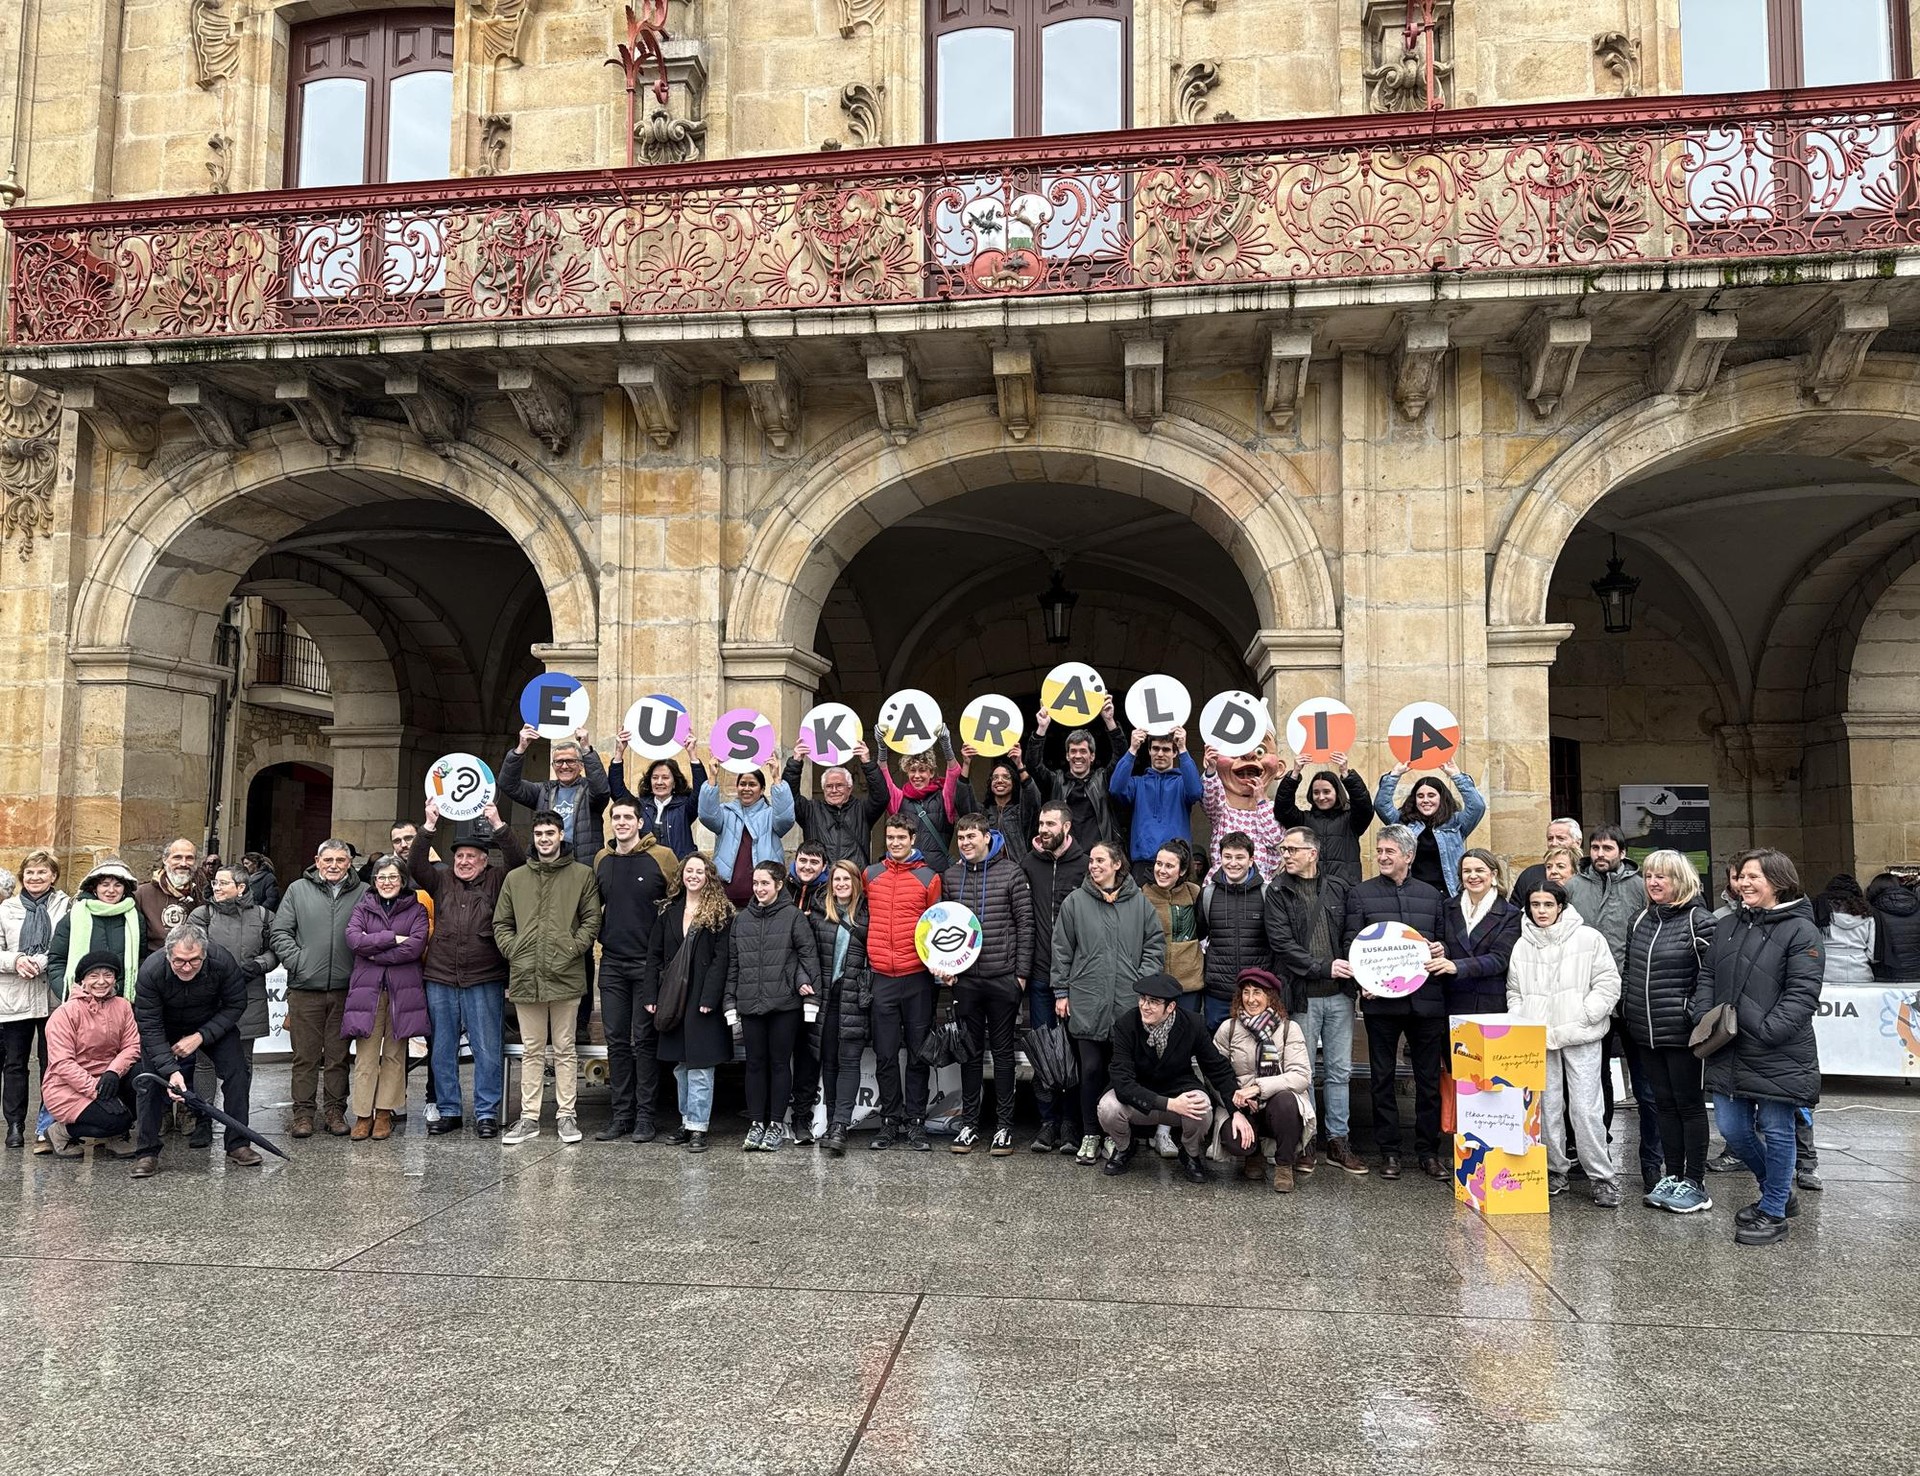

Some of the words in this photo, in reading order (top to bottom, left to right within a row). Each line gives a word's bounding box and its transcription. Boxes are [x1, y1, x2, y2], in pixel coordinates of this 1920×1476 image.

[538, 685, 572, 726] E
[1050, 675, 1091, 715] A
[1143, 688, 1175, 724] L
[637, 706, 679, 747] U
[726, 720, 761, 760] S
[813, 714, 852, 755] K
[891, 703, 932, 742] A
[973, 705, 1011, 747] R
[1210, 700, 1257, 745] D
[1314, 711, 1329, 750] I
[1409, 715, 1454, 762] A
[938, 951, 971, 968] AHOBIZI
[1362, 944, 1417, 953] EUSKARALDIA
[1813, 1001, 1860, 1018] DIA
